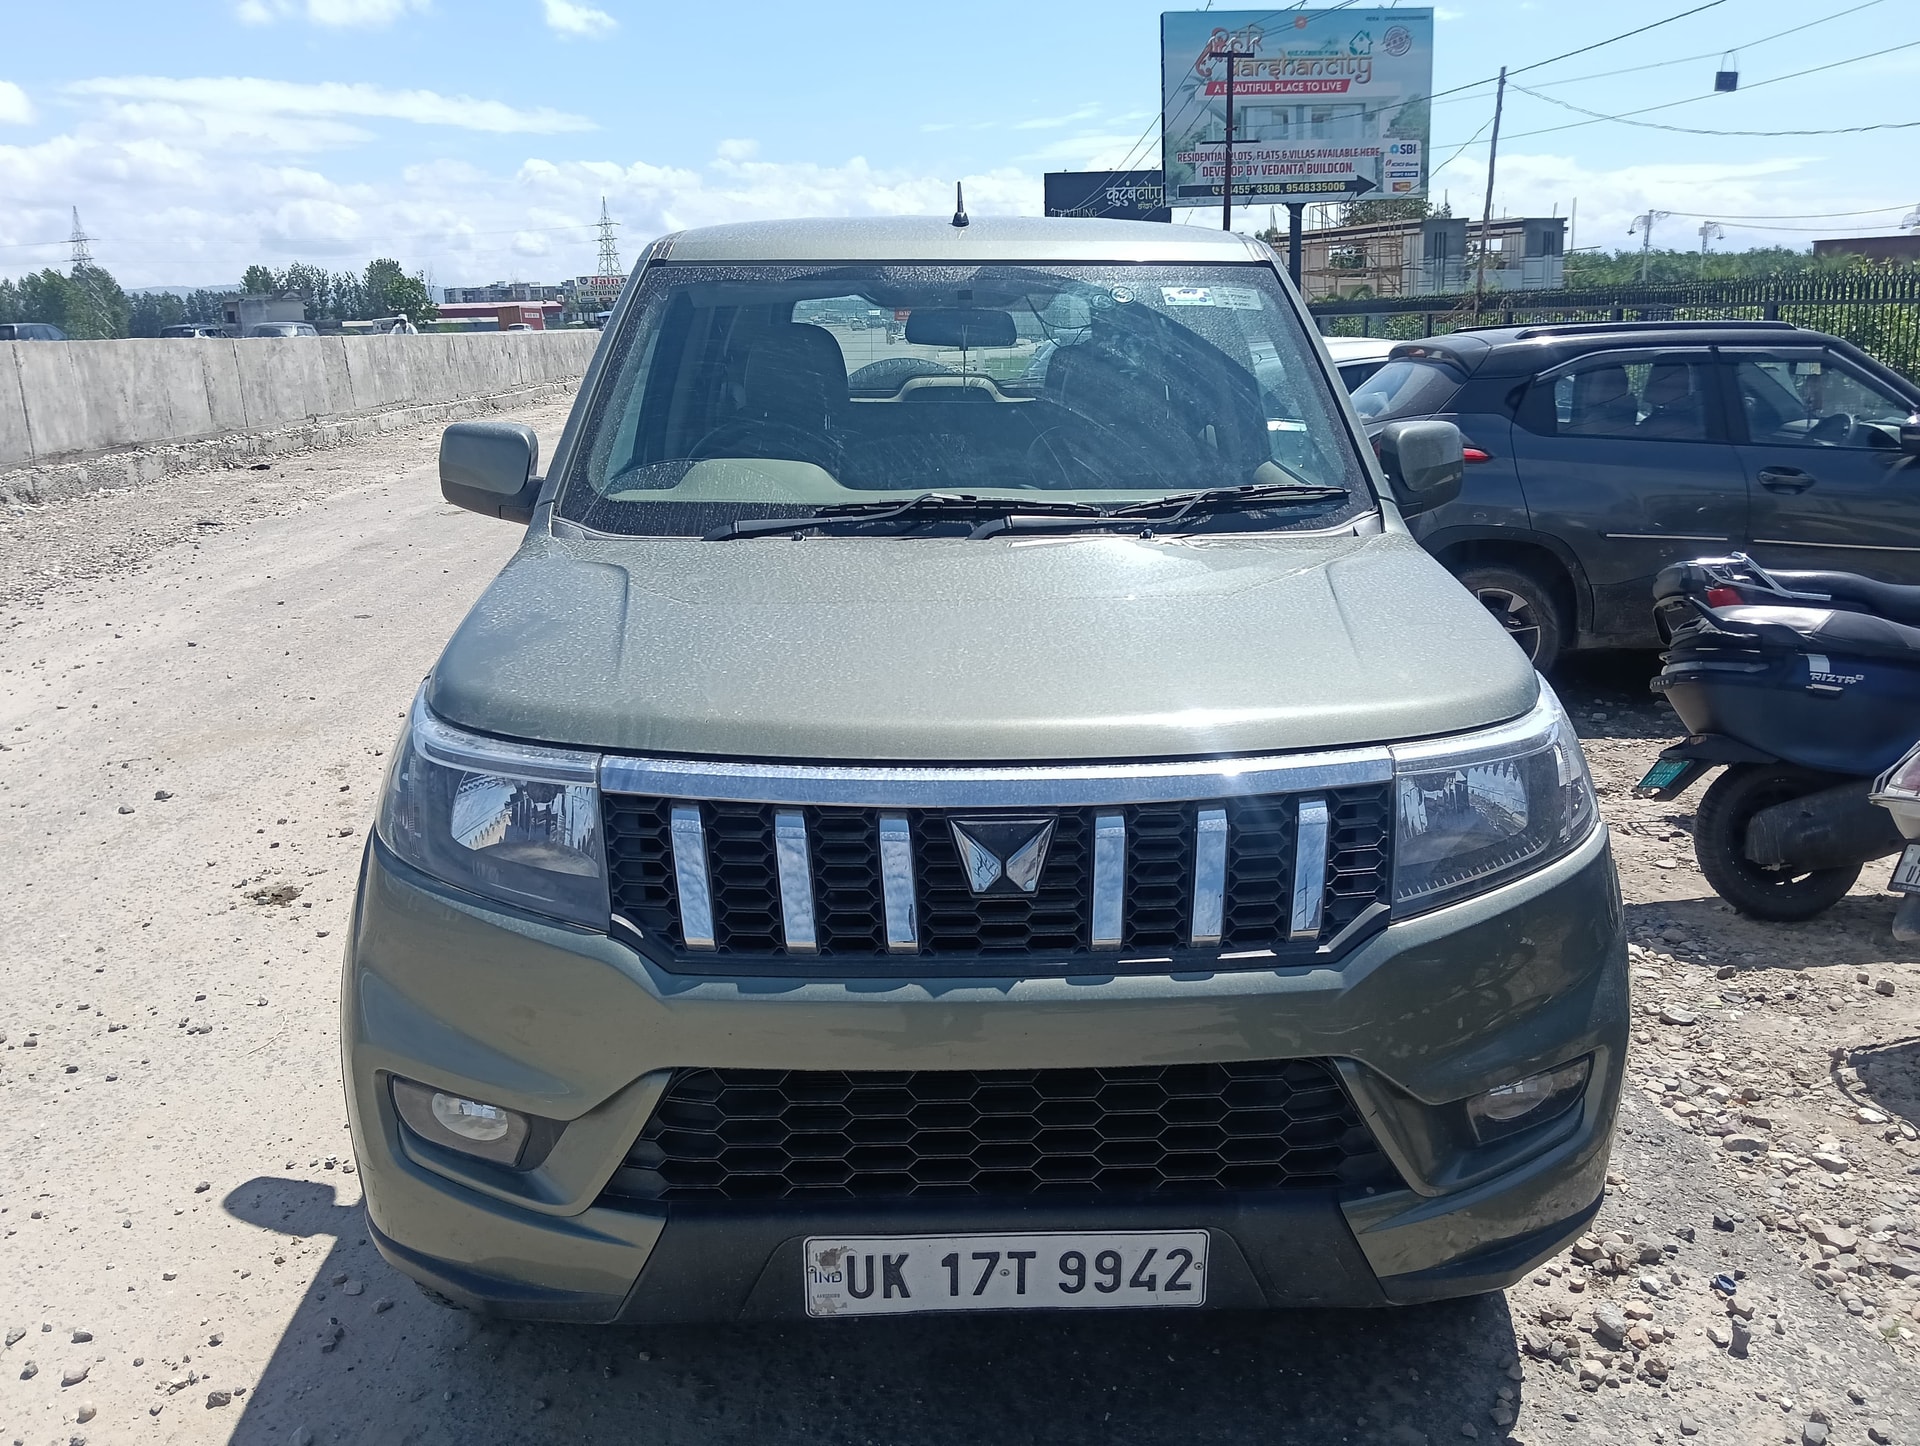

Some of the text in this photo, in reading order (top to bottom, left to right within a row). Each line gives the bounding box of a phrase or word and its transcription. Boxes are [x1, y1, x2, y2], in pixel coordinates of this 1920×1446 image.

[1214, 84, 1221, 93] A
[1275, 82, 1304, 92] PLACE
[1307, 82, 1319, 91] TO
[1321, 81, 1342, 91] LIVE
[1229, 151, 1255, 161] LOTS,
[1257, 150, 1280, 160] FLATS
[1282, 150, 1288, 159] &
[1289, 149, 1315, 159] VILLAS
[1317, 148, 1358, 158] AVAILABLE
[1360, 147, 1380, 156] HERE
[1400, 144, 1416, 154] SBI
[1202, 162, 1355, 177] DEVEOP BY VEDANTA BUILDCON.
[1286, 182, 1345, 193] 9548335006
[591, 276, 619, 285] Jain
[814, 1270, 842, 1283] IND
[846, 1254, 911, 1299] UK
[1058, 1248, 1193, 1295] 9942
